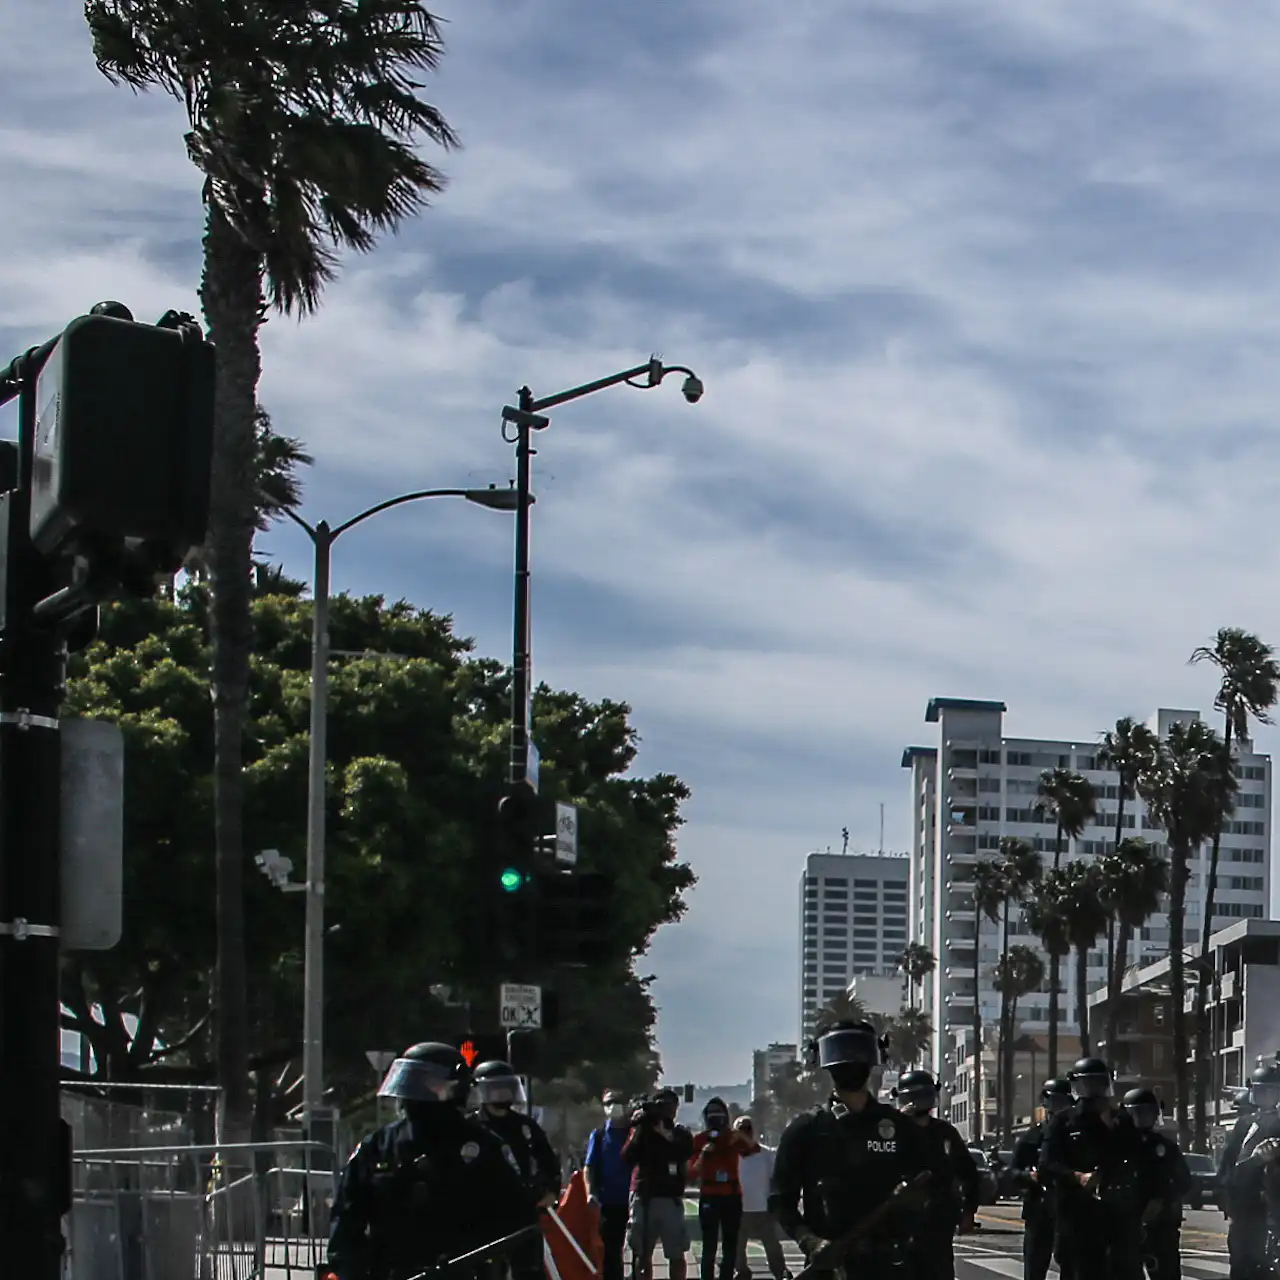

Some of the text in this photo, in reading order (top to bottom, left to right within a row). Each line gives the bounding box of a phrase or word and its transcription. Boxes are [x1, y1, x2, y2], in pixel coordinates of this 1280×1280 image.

[503, 1006, 517, 1021] OK
[1211, 1135, 1224, 1144] 30
[868, 1140, 897, 1152] POLICE
